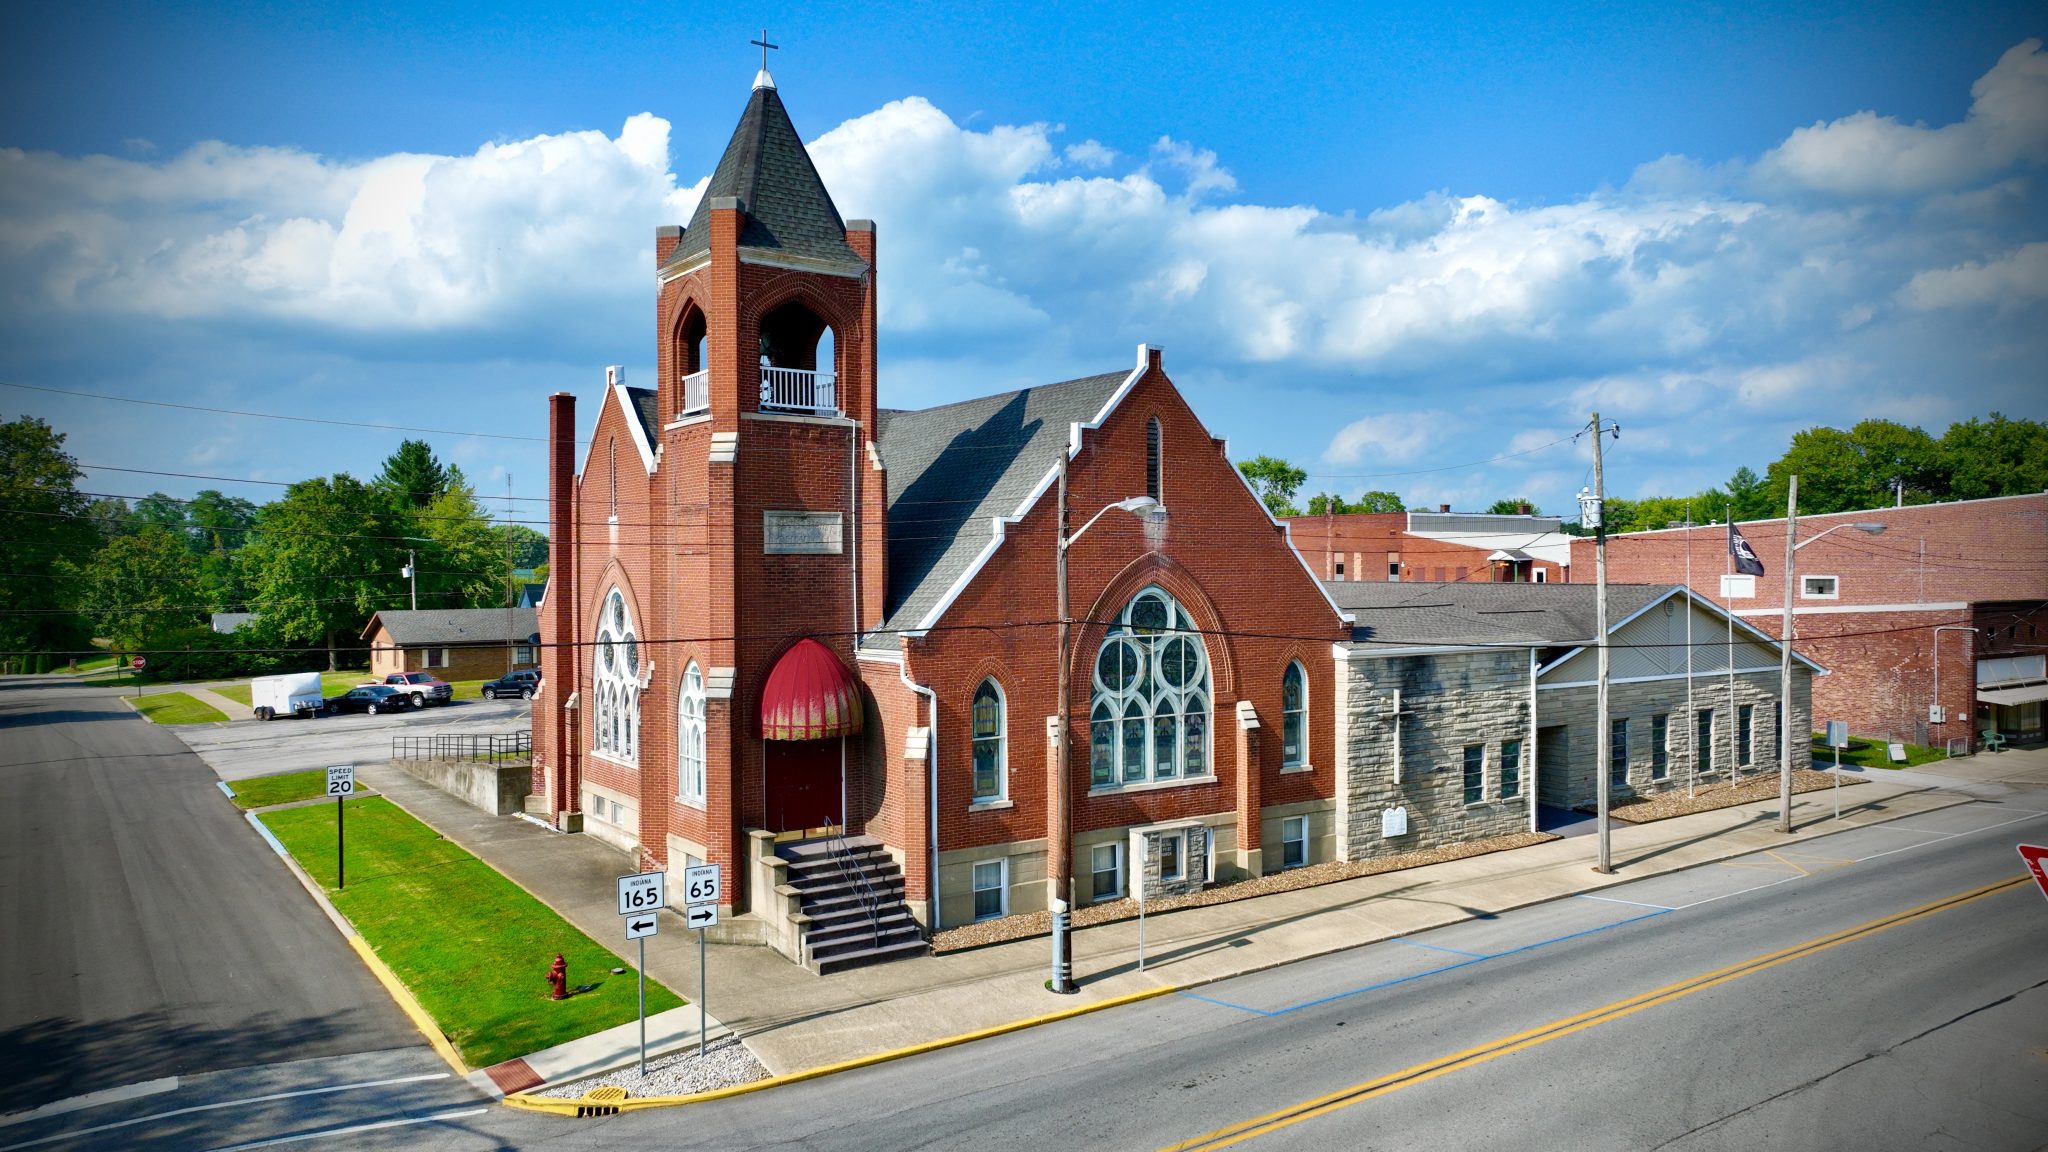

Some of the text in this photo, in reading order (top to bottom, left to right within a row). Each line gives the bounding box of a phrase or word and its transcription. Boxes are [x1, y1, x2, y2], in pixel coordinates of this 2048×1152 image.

[330, 781, 351, 793] 20
[692, 869, 713, 877] INDIANA
[630, 879, 652, 887] INDIANA
[690, 880, 715, 898] 65
[624, 887, 657, 908] 165
